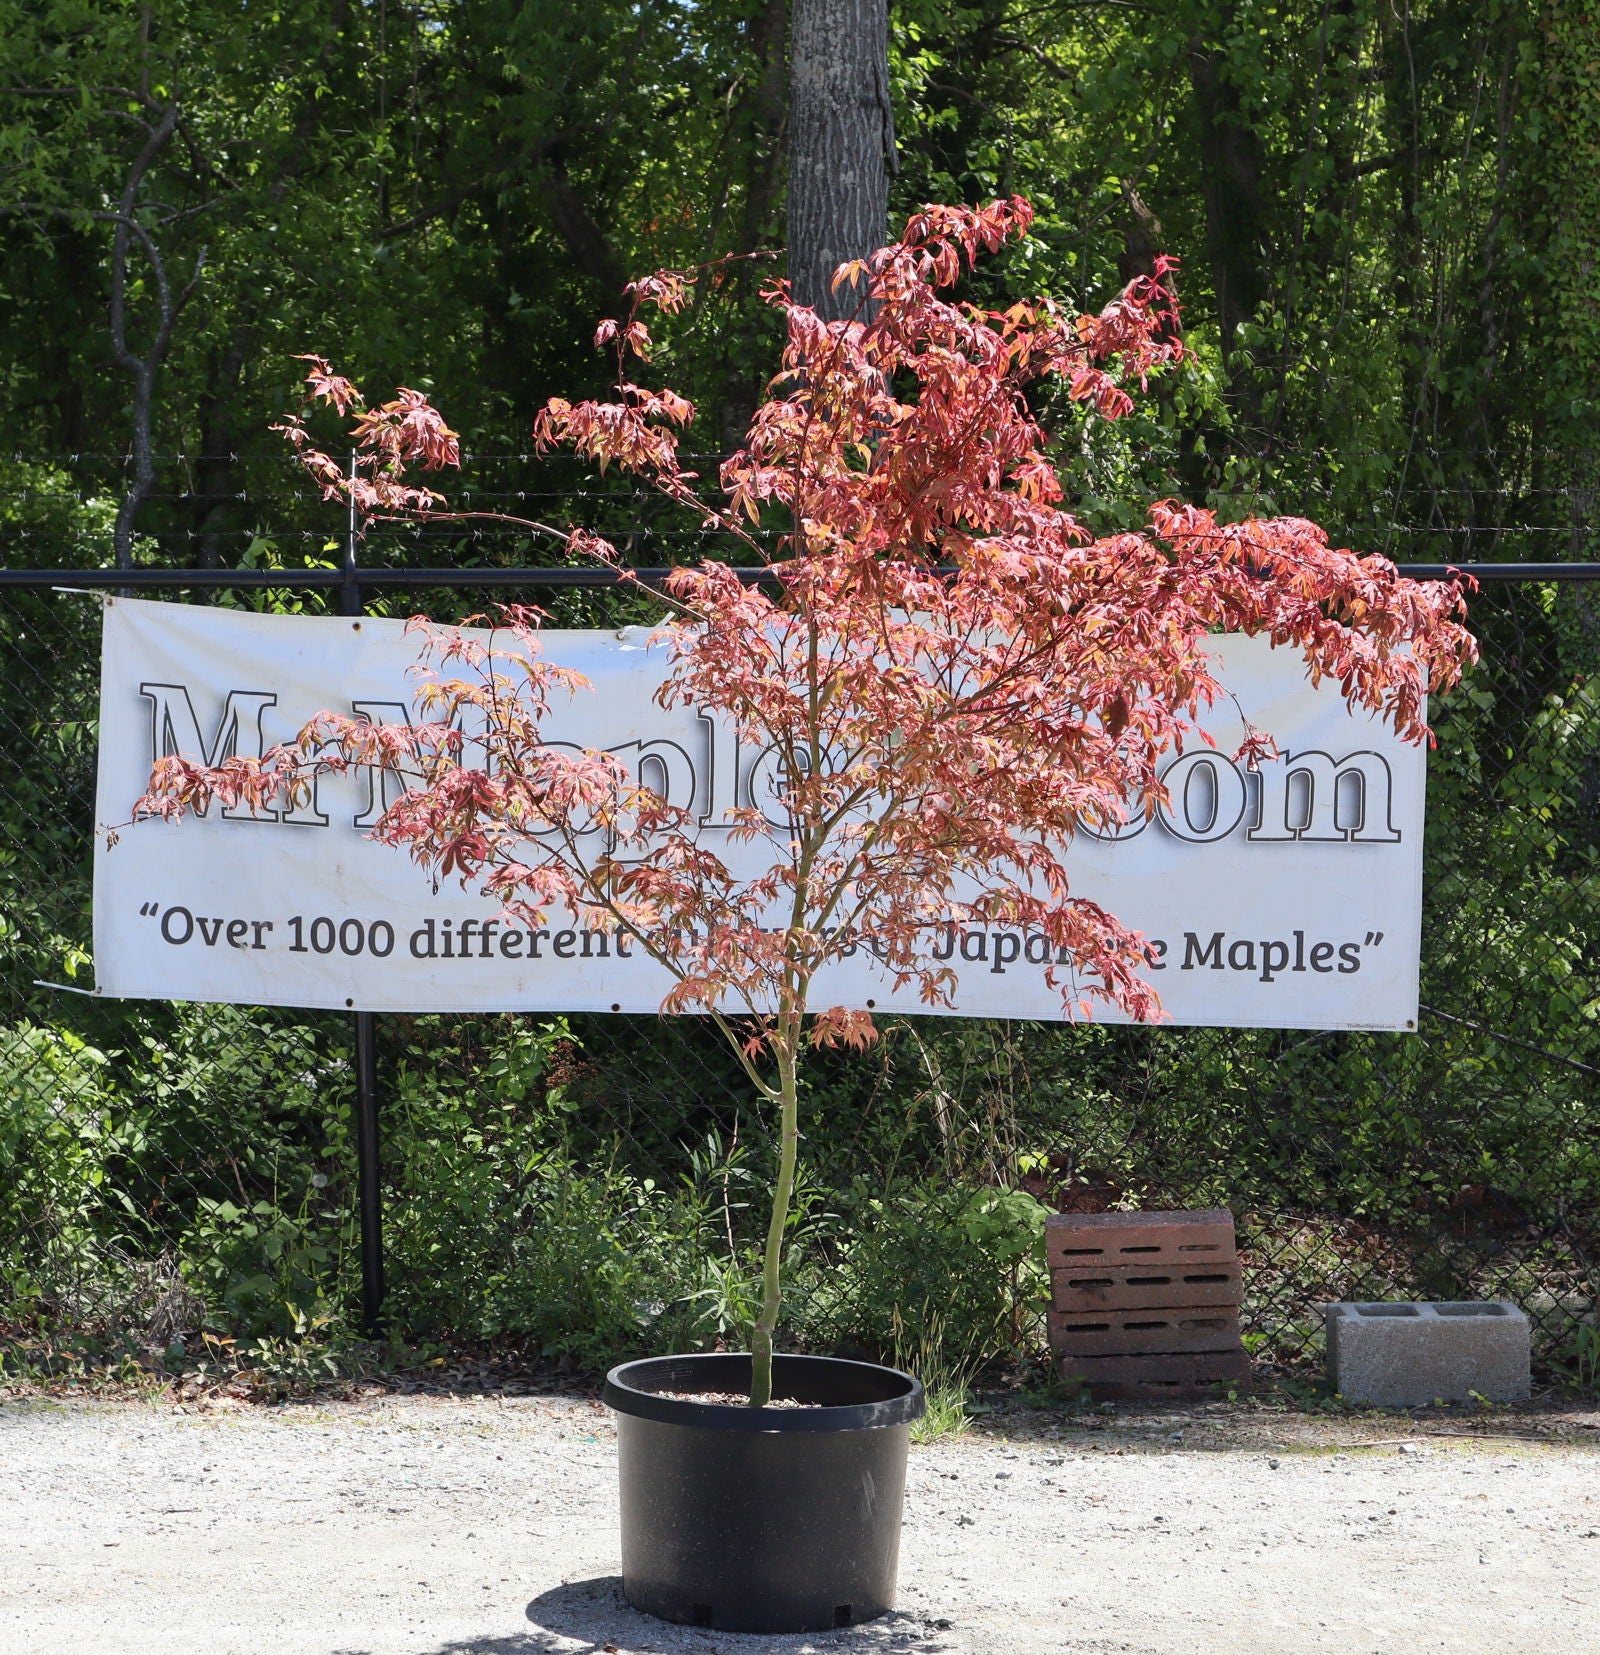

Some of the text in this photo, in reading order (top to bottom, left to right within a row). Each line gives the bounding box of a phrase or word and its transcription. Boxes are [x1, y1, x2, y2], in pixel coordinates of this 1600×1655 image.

[141, 902, 275, 949] “Over
[287, 916, 395, 958] 1000
[409, 918, 633, 959] different
[931, 924, 1169, 974] Japae
[1180, 930, 1384, 983] Maples”
